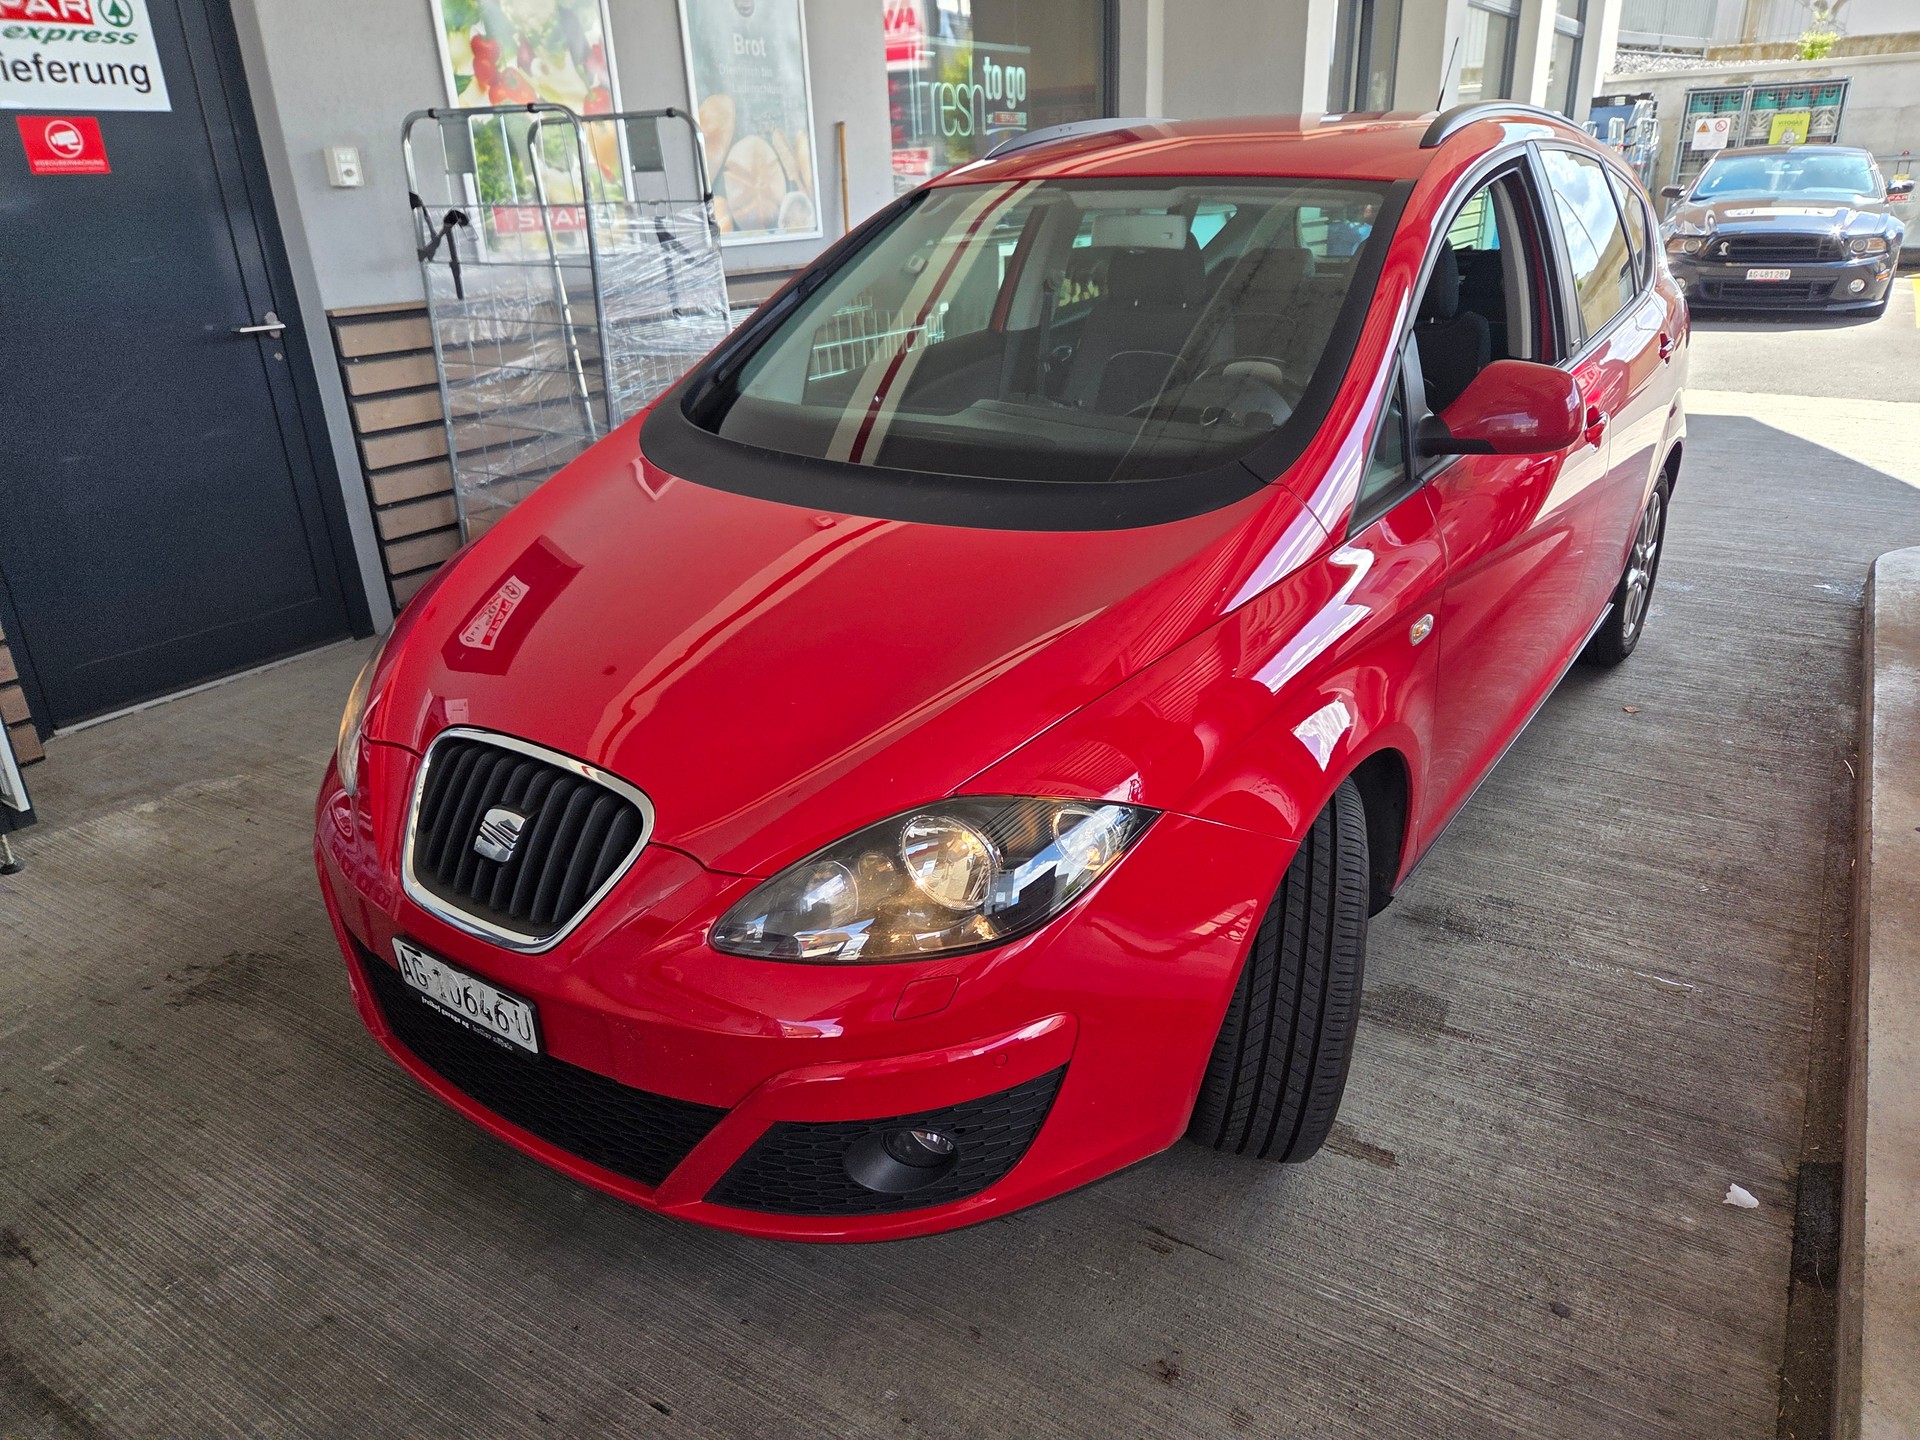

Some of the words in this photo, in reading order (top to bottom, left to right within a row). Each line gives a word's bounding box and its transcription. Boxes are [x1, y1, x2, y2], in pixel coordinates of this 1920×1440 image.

[3, 26, 138, 45] express
[733, 33, 766, 57] Brot
[0, 52, 151, 93] ieferung
[915, 50, 985, 136] Fresh
[983, 56, 1002, 100] to
[1005, 66, 1026, 109] go
